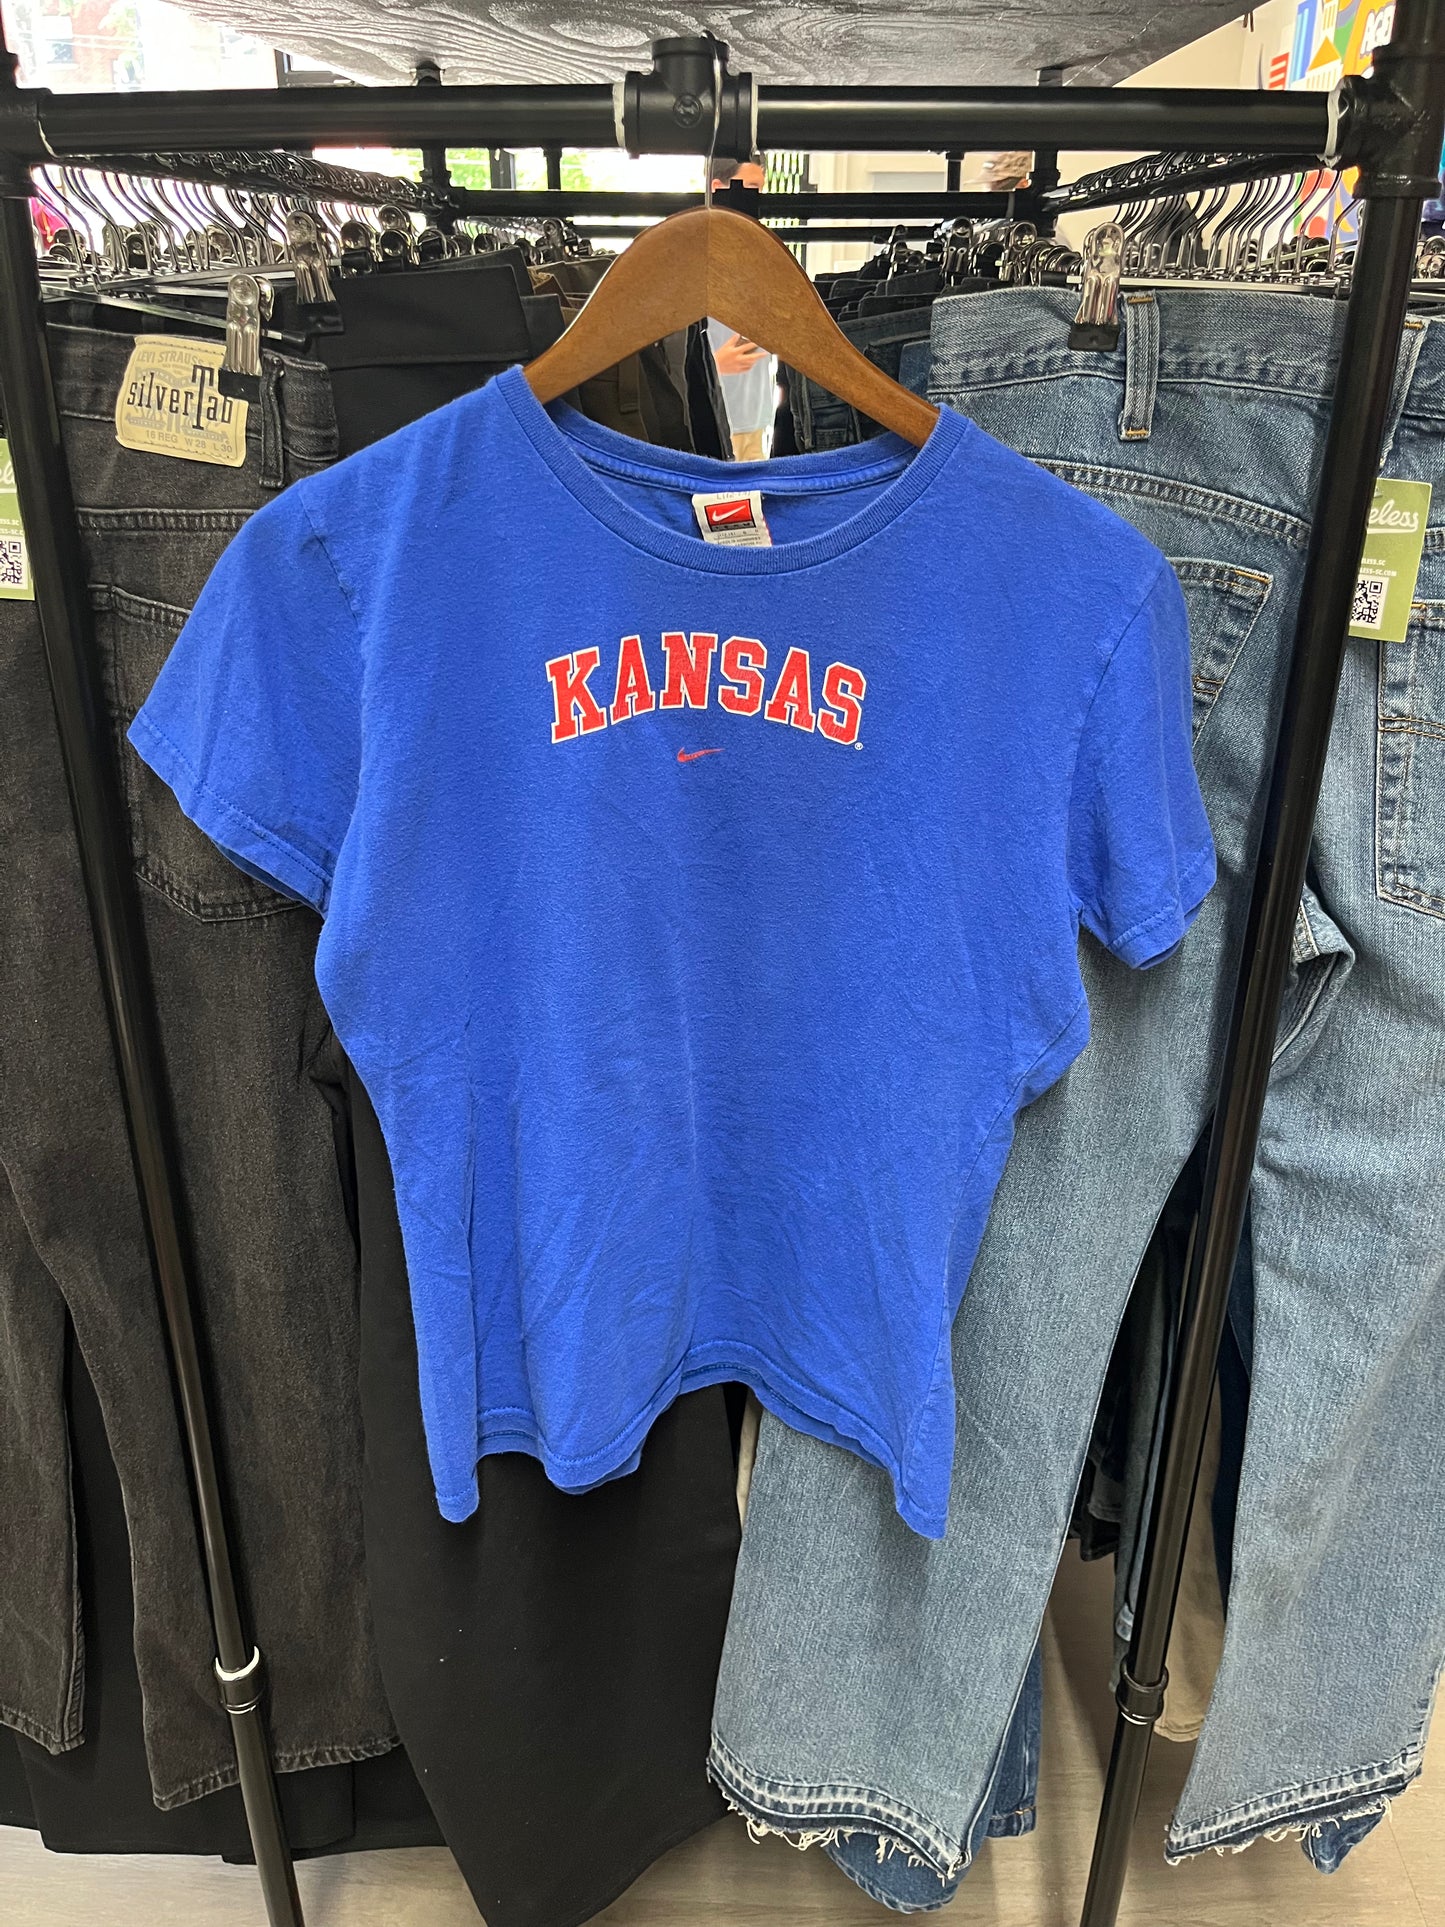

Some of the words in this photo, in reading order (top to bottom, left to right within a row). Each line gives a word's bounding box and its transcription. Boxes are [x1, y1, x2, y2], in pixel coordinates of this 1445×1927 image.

[136, 351, 155, 363] LEVI
[127, 365, 233, 430] silverTab
[146, 430, 156, 439] 16
[158, 432, 178, 443] REG
[195, 439, 206, 448] 28
[221, 444, 232, 453] 30
[545, 631, 867, 745] KANSAS
